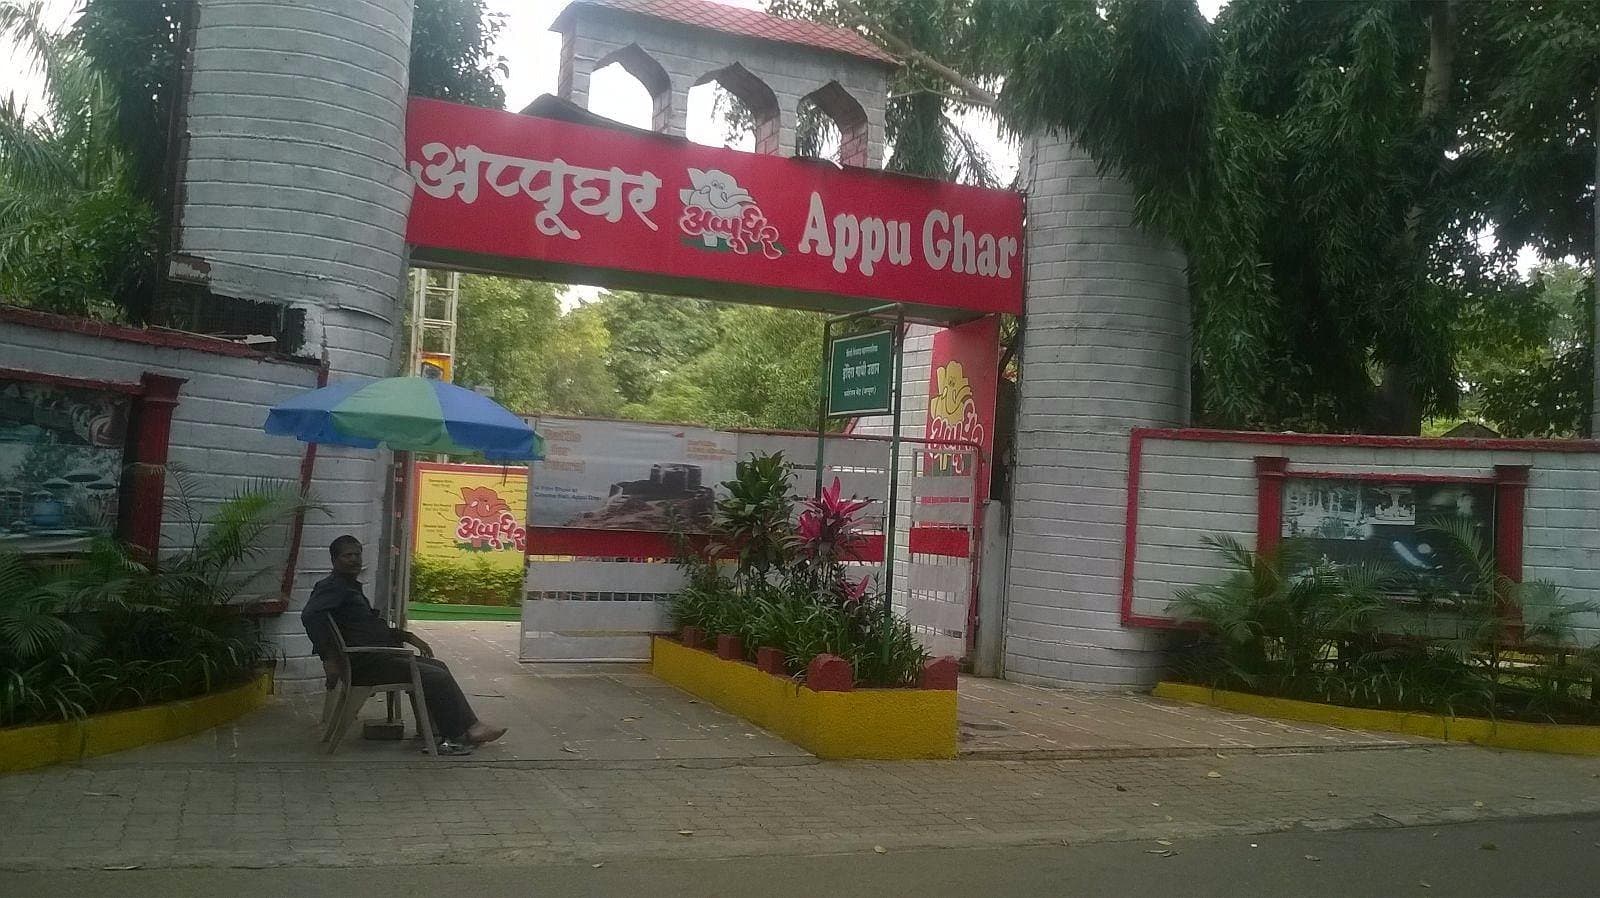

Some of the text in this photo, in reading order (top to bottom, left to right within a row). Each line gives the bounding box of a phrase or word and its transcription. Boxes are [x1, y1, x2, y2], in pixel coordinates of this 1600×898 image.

[410, 142, 662, 240] अप्पूघर
[798, 192, 1016, 278] Appu Ghar
